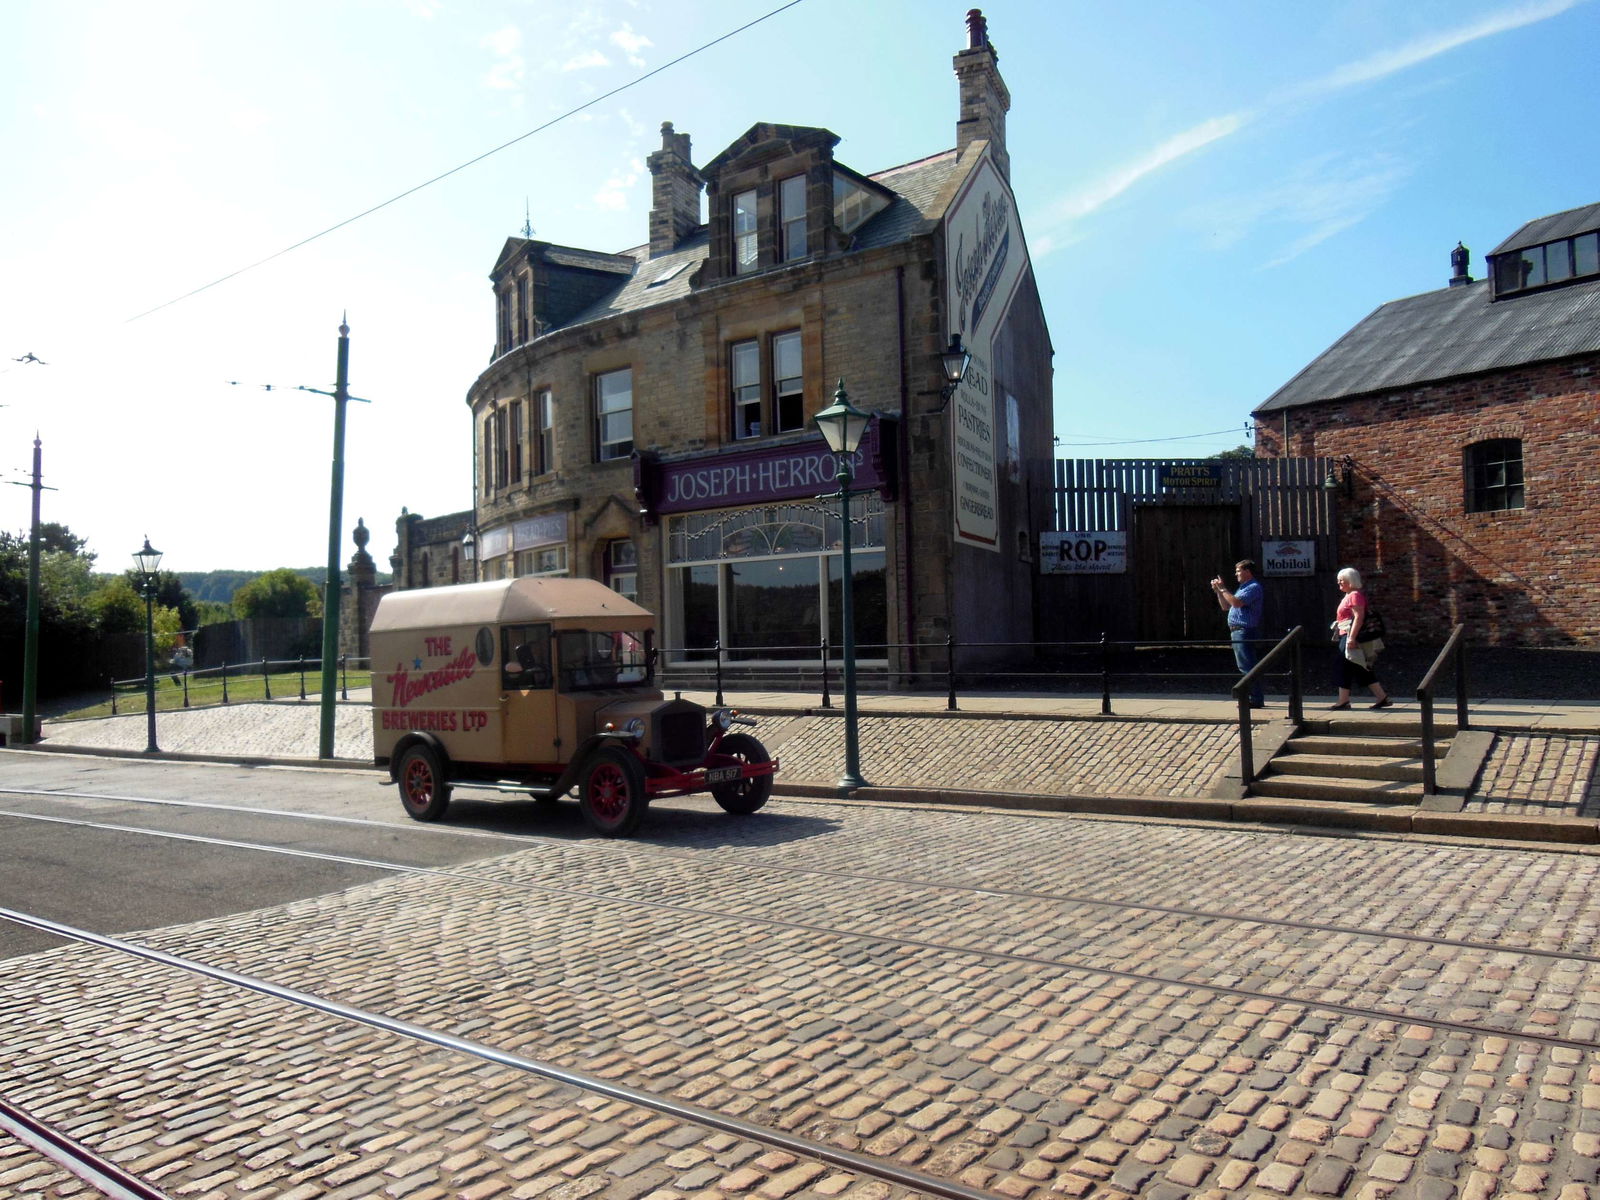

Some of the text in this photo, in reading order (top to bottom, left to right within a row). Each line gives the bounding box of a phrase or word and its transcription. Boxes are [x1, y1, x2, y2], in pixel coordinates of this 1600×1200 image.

[958, 404, 991, 444] PASTRIES
[668, 464, 750, 503] JOSEPH
[1162, 476, 1218, 487] MOTOR SPIRIT
[1266, 558, 1312, 570] Mobiloil
[424, 635, 454, 657] THE
[387, 646, 477, 707] Newcastle
[382, 710, 488, 732] BREWERIES LTD
